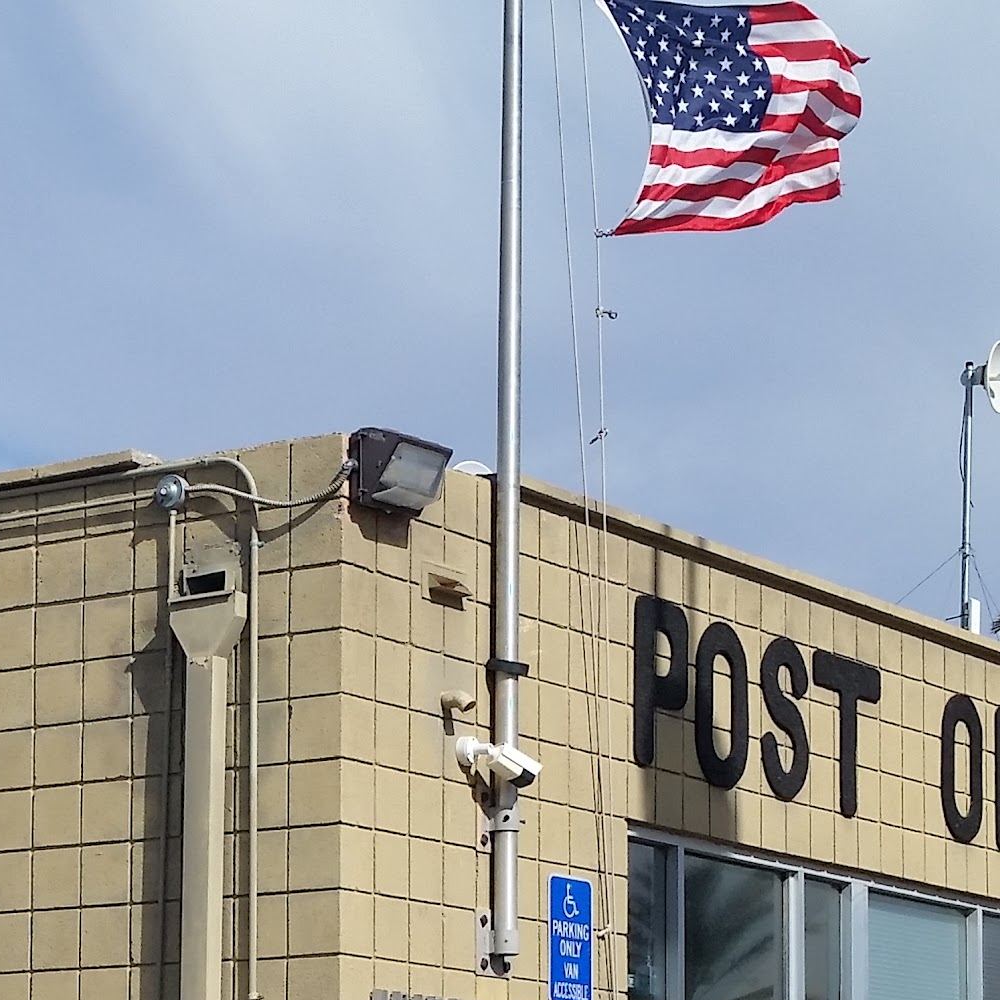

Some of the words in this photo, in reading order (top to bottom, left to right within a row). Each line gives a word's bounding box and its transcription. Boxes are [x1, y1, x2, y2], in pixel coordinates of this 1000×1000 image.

[633, 595, 881, 818] POST
[552, 919, 590, 942] PARKING
[559, 939, 582, 959] ONLY
[563, 961, 579, 980] VAN
